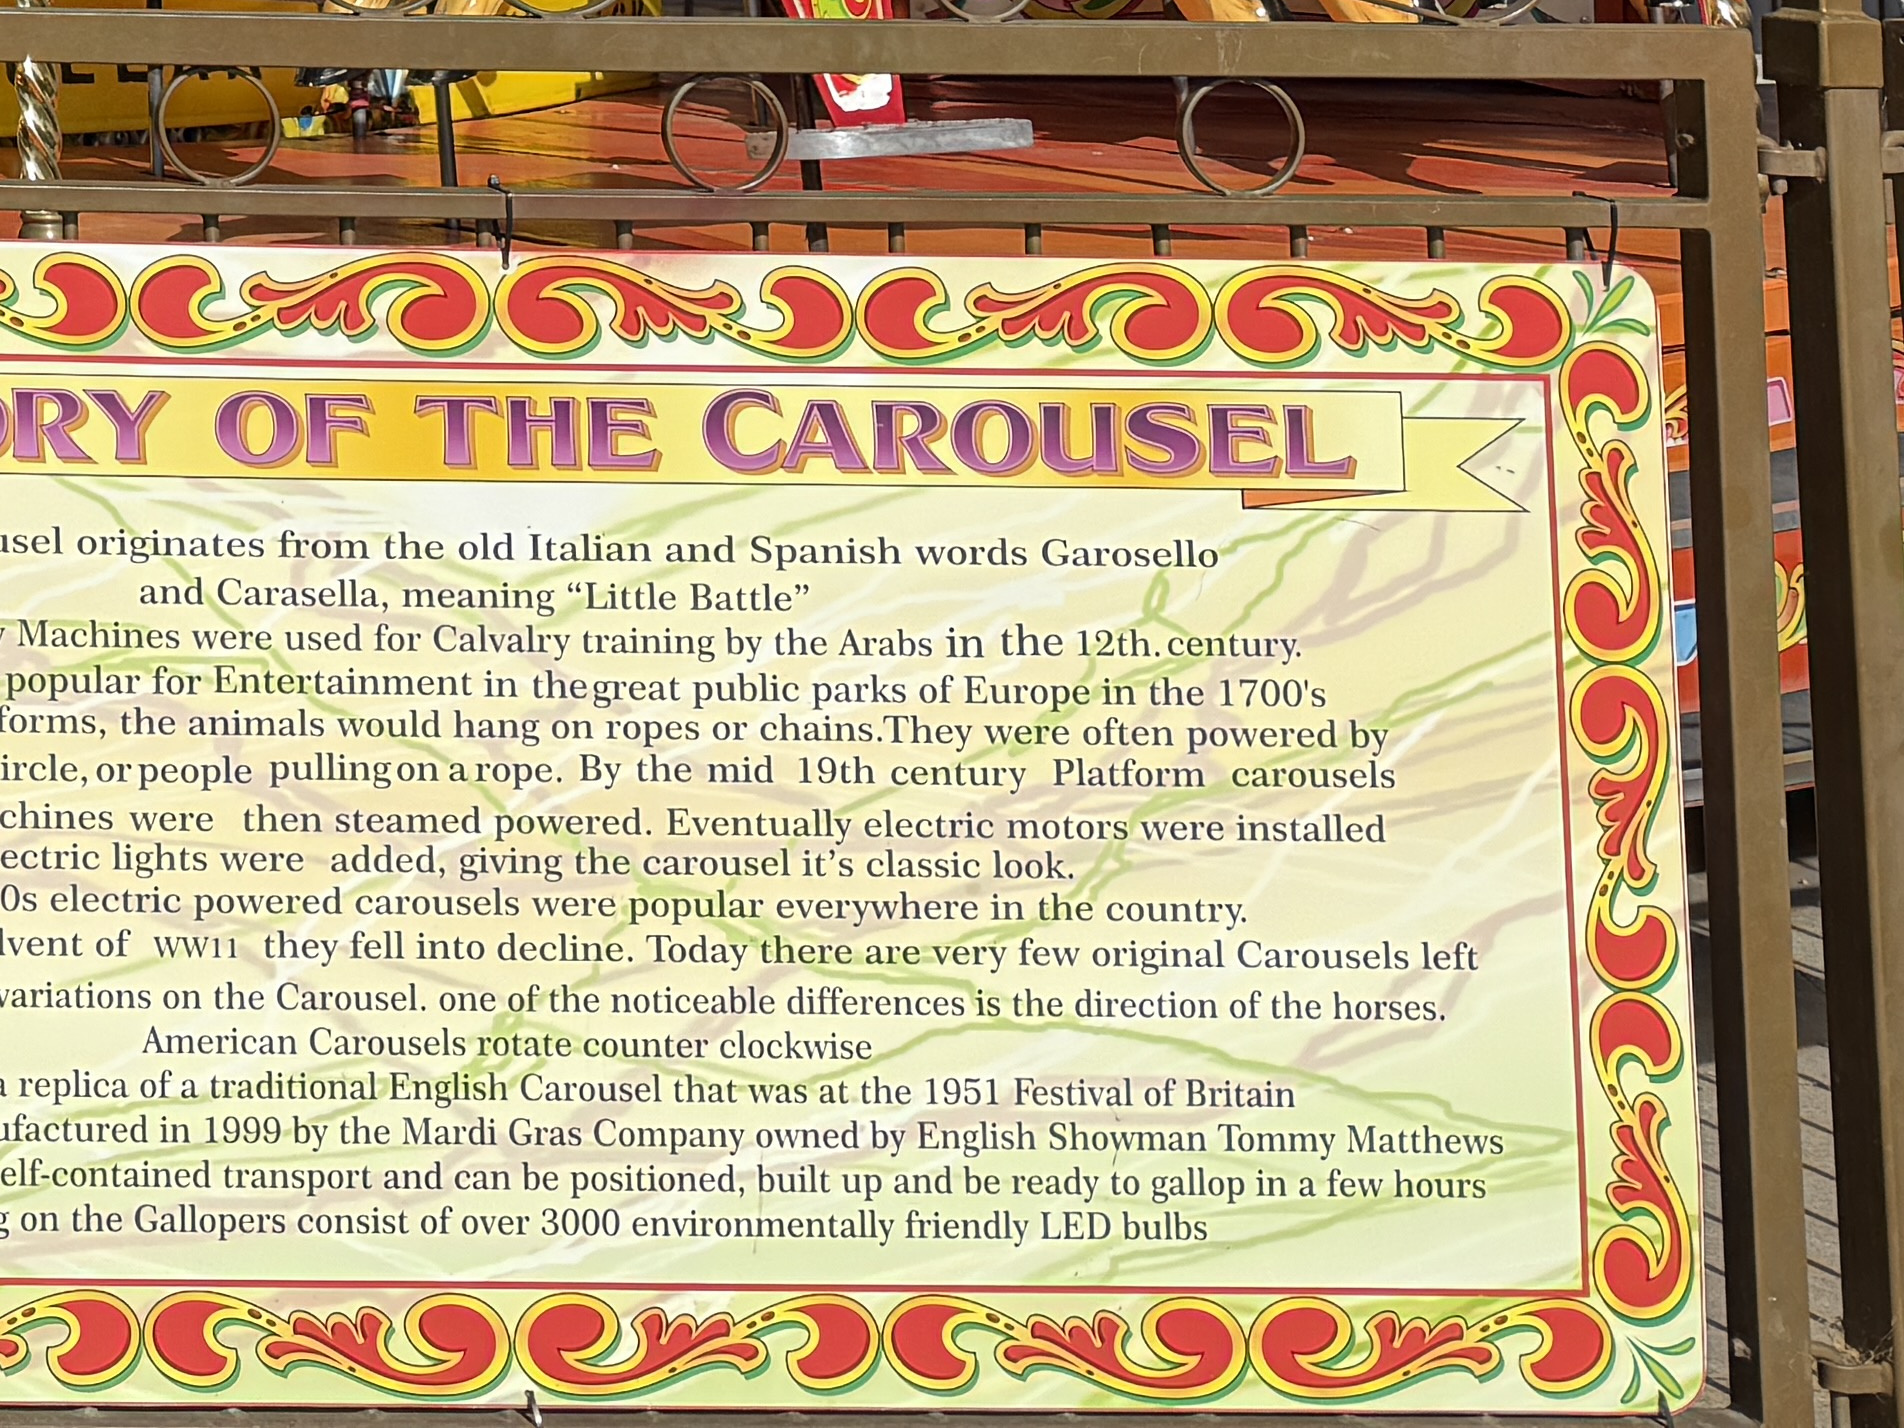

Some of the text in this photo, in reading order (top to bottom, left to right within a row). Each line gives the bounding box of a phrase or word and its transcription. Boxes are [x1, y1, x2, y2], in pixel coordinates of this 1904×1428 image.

[215, 389, 372, 469] OF
[413, 391, 664, 474] THE
[700, 387, 1359, 480] CAROUSEL
[76, 528, 265, 564] originates
[277, 529, 370, 560] from
[384, 530, 445, 561] the
[458, 532, 515, 561] old
[529, 532, 652, 562] Italian
[665, 534, 736, 563] and
[750, 535, 902, 572] Spanish
[914, 537, 1028, 566] words
[1041, 538, 1219, 568] Garosello
[139, 576, 205, 606] and
[217, 577, 389, 614] Carasella,
[402, 581, 555, 618] meaning
[129, 811, 214, 832] were
[243, 803, 323, 833] then
[335, 805, 482, 834] steamed
[494, 806, 652, 843] powered.
[666, 807, 852, 846] Eventually
[864, 809, 994, 839] electric
[1006, 815, 1129, 841] motors
[1140, 821, 1224, 842] were
[1235, 813, 1386, 843] installed
[112, 841, 208, 879] lights
[219, 852, 304, 873] were
[330, 843, 446, 879] added,
[459, 846, 563, 883] giving
[575, 846, 631, 876] the
[643, 847, 791, 877] carousel
[866, 848, 981, 879] classic
[992, 849, 1074, 880] look.
[50, 883, 182, 914] electric
[193, 886, 343, 922] powered
[355, 886, 520, 917] carousels
[531, 896, 617, 917] were
[628, 889, 764, 926] popular
[776, 890, 979, 928] everywhere
[990, 893, 1025, 921] in
[1038, 892, 1094, 922] the
[1106, 898, 1247, 932] country.
[95, 928, 132, 958] of
[264, 929, 339, 968] they
[349, 930, 405, 960] fell
[416, 932, 485, 961] into
[497, 931, 634, 963] decline.
[645, 934, 749, 972] Today
[760, 934, 853, 965] there
[865, 944, 921, 965] are
[931, 945, 1008, 974] very
[1018, 936, 1081, 967] few
[1092, 938, 1226, 976] original
[1237, 939, 1410, 970] Carousels
[1421, 941, 1479, 971] left
[141, 1025, 872, 1061] American Carousels rotate counter clockwise
[18, 1068, 130, 1106] replica
[139, 1069, 173, 1099] of
[180, 1078, 200, 1100] a
[210, 1070, 379, 1101] traditional
[389, 1071, 509, 1109] English
[520, 1072, 663, 1103] Carousel
[673, 1073, 738, 1104] that
[747, 1083, 808, 1104] was
[819, 1080, 850, 1105] at
[860, 1075, 912, 1106] the
[925, 1077, 999, 1106] 1951
[1014, 1077, 1134, 1107] Festival
[1144, 1077, 1177, 1107] of
[1185, 1078, 1296, 1108] Britain
[20, 1212, 60, 1232] on
[72, 1202, 123, 1233] the
[134, 1203, 286, 1242] Gallopers
[297, 1206, 410, 1235] consist
[420, 1205, 454, 1235] of
[461, 1214, 530, 1236] over
[541, 1207, 621, 1237] 3000
[631, 1209, 895, 1247] environmentally
[905, 1209, 1029, 1248] friendly
[1040, 1211, 1111, 1240] LED
[1121, 1210, 1208, 1241] bulbs
